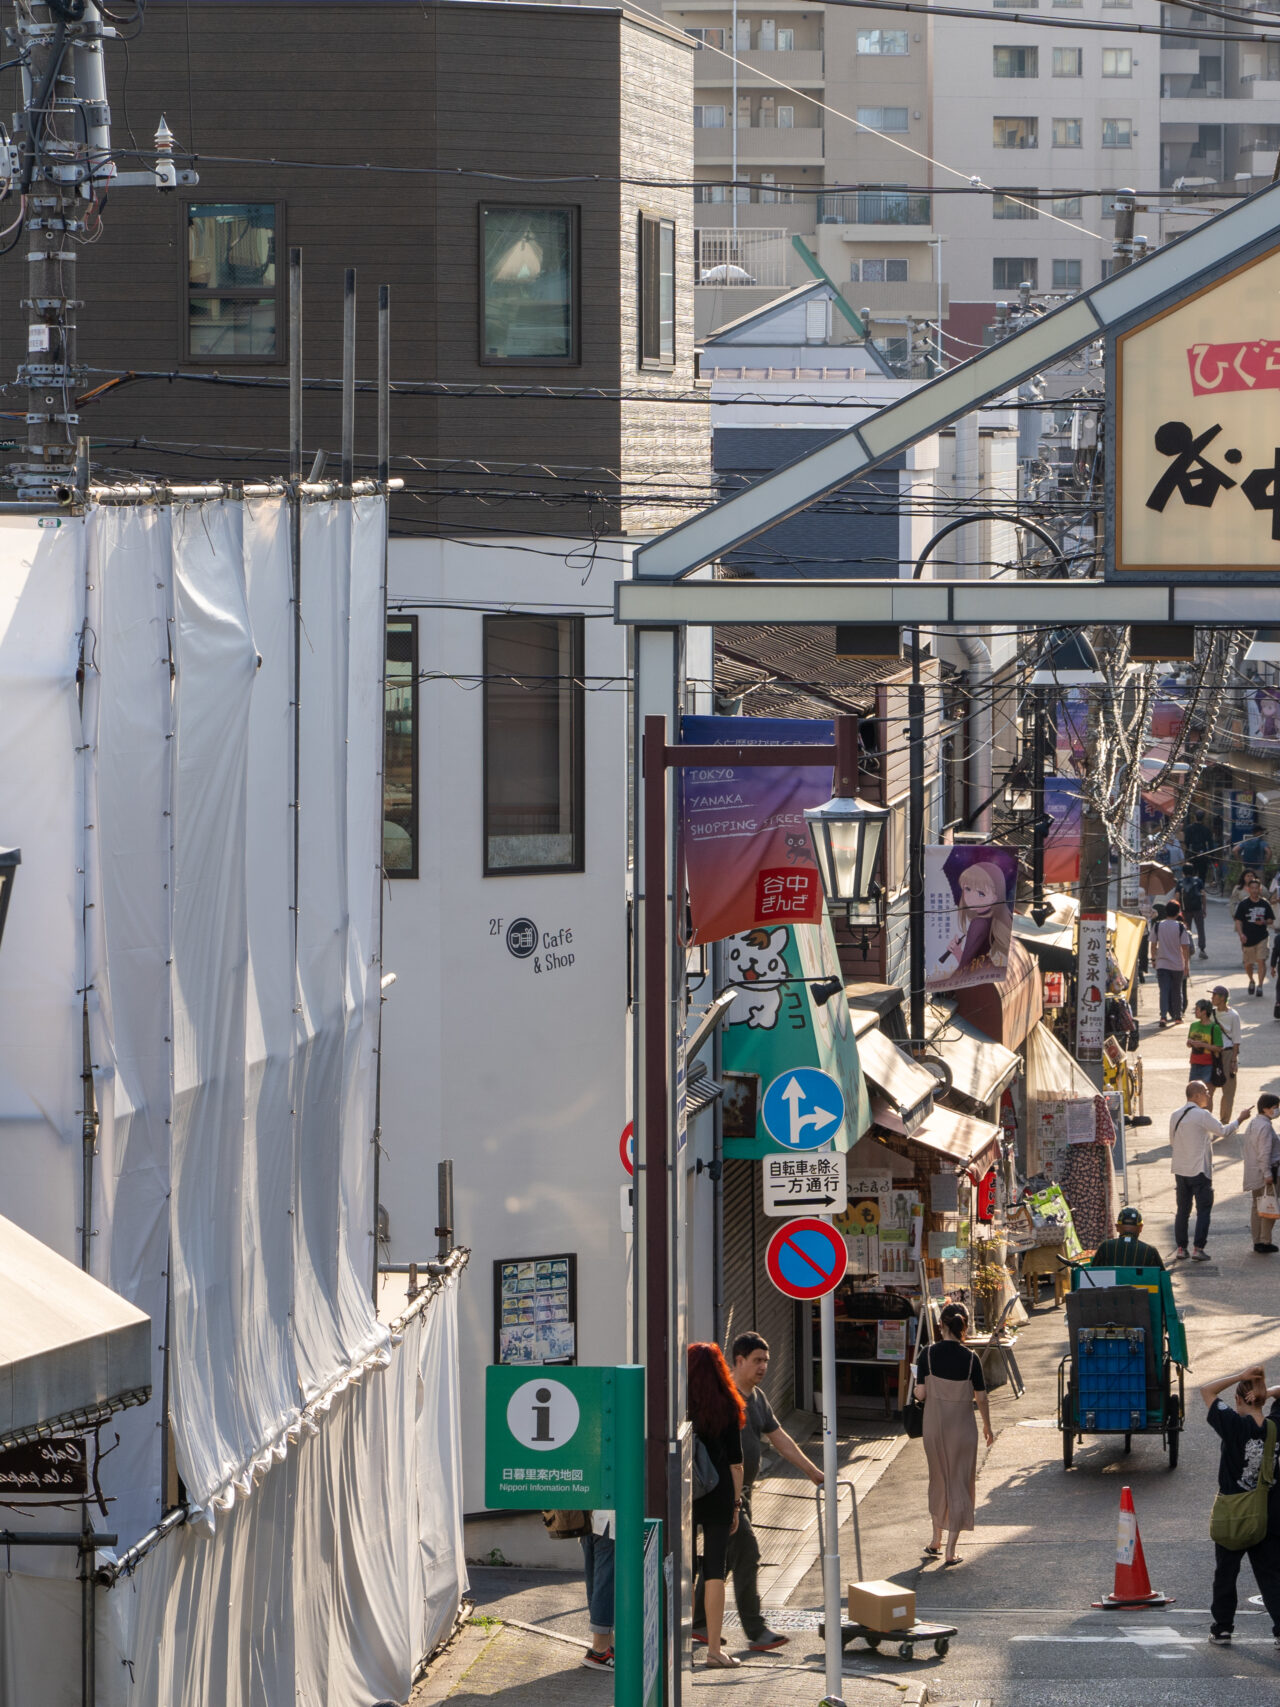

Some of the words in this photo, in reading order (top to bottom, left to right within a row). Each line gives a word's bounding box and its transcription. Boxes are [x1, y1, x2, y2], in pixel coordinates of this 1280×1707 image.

[690, 768, 734, 781] TOKYO
[689, 793, 743, 807] YANAKA
[690, 819, 757, 836] SHOPPING
[764, 875, 808, 894] 谷中
[761, 894, 808, 914] ぎんざ
[489, 918, 504, 936] 2F
[542, 927, 573, 949] Café
[533, 956, 542, 974] &
[545, 953, 575, 971] Shop
[1086, 937, 1100, 981] かき氷
[770, 1159, 839, 1176] 自転車を除く
[770, 1177, 840, 1193] 一方通行
[503, 1468, 583, 1481] 日暮里案内地図
[499, 1483, 527, 1492] Nippori
[572, 1484, 590, 1493] Map
